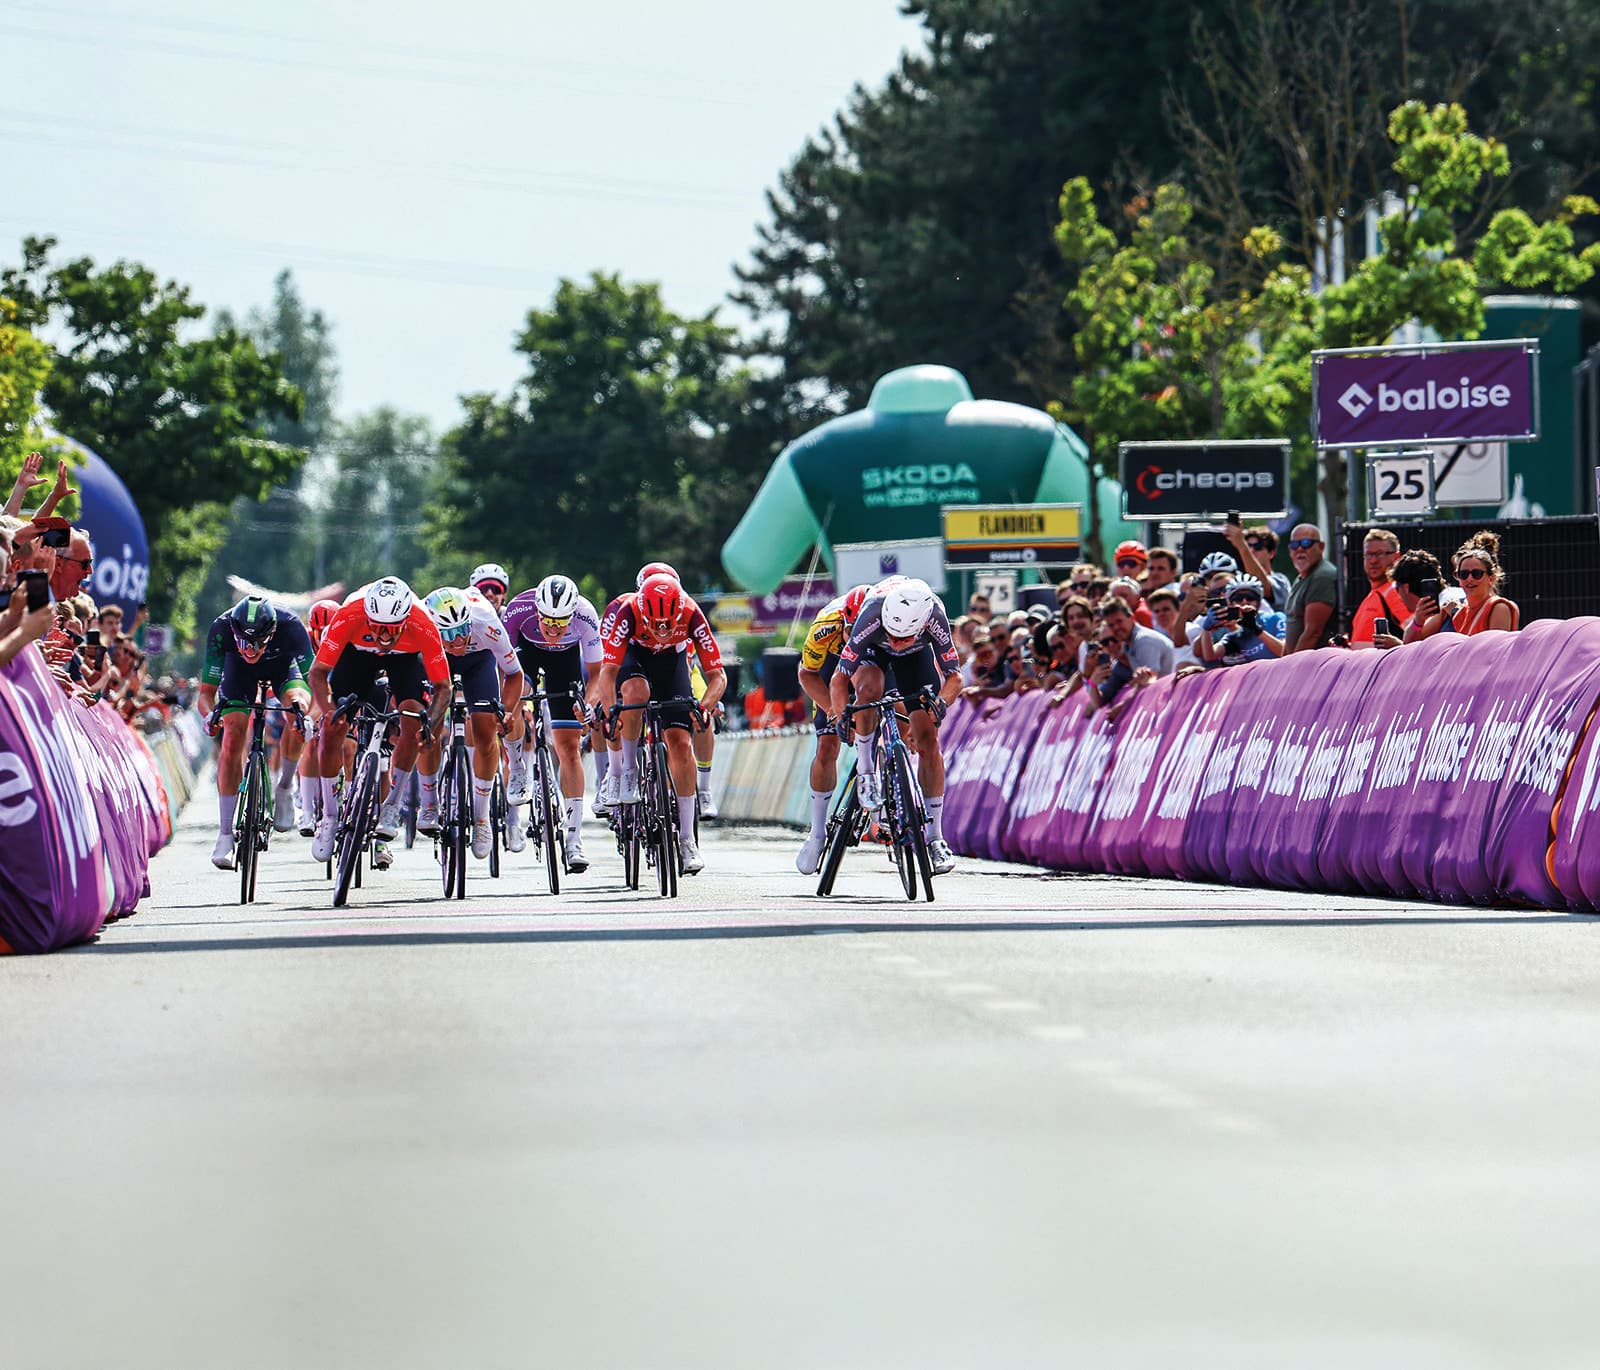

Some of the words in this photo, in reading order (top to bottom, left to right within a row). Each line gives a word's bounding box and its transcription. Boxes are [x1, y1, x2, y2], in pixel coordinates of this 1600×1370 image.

[1378, 376, 1511, 412] baloise
[1155, 468, 1274, 492] cheops
[1380, 469, 1424, 500] 25
[985, 586, 1008, 600] 75
